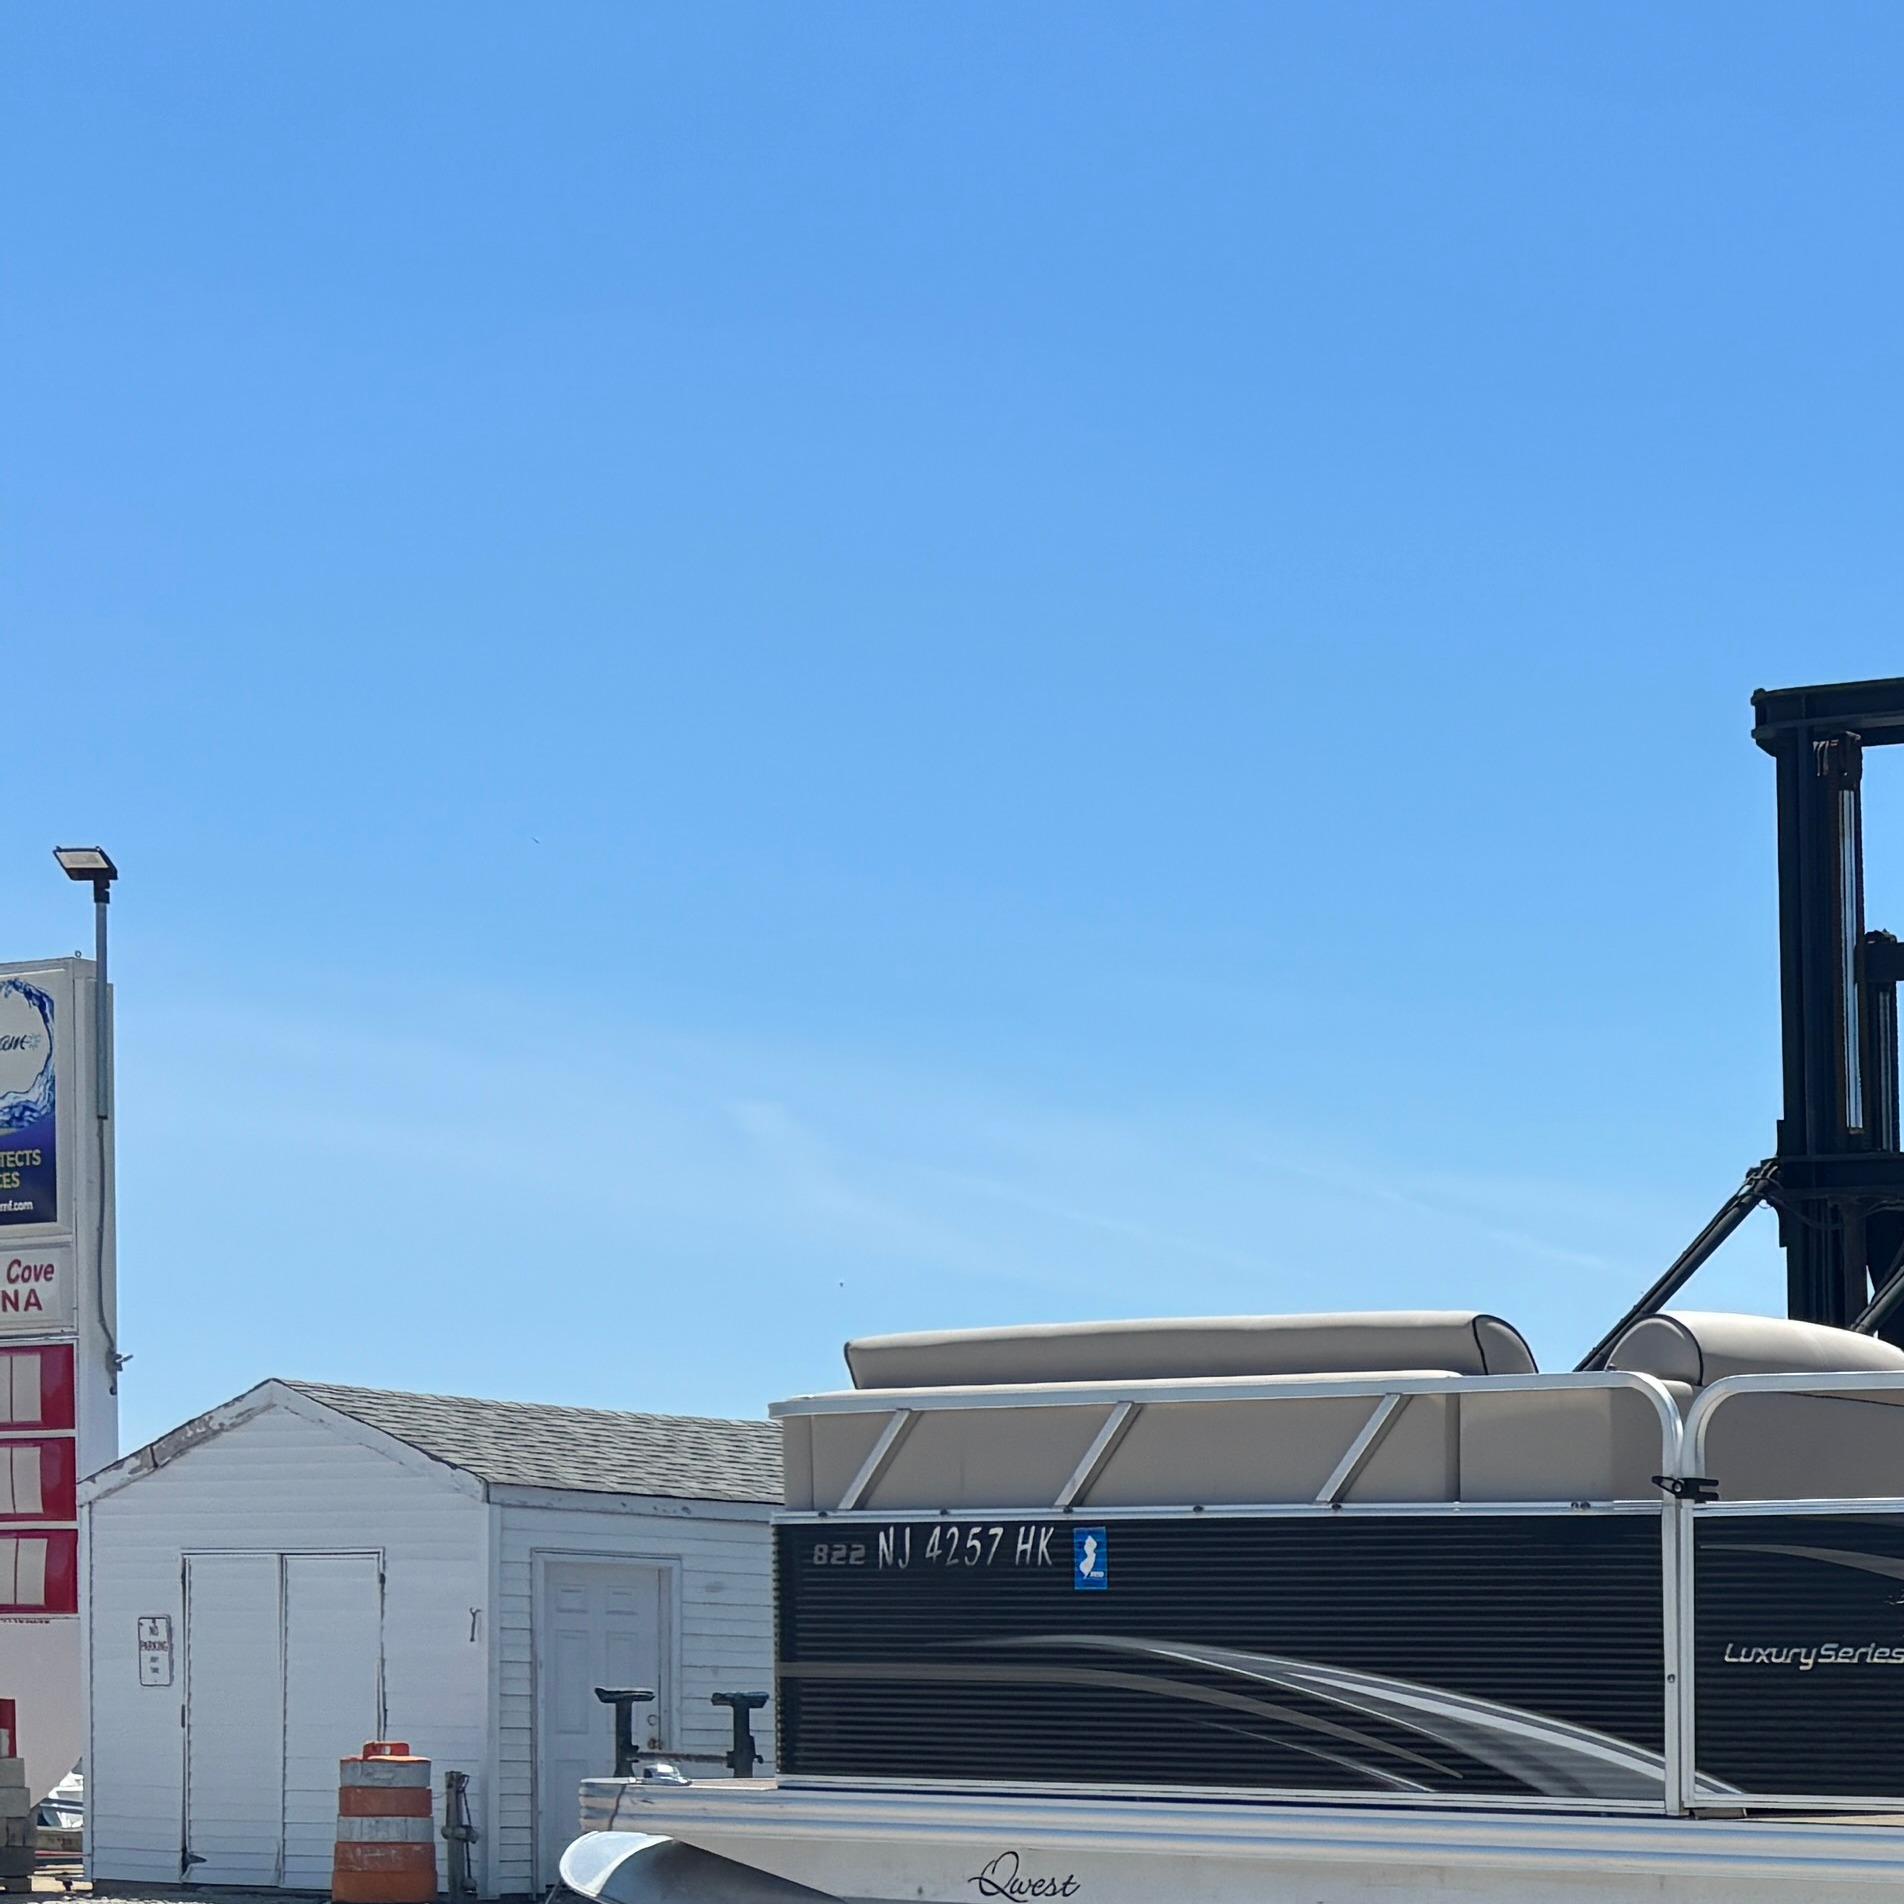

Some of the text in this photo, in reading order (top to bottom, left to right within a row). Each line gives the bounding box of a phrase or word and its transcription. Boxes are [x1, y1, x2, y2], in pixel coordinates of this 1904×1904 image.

[6, 1258, 55, 1285] Cove
[813, 1544, 865, 1565] 822
[878, 1525, 1055, 1570] NJ 4257 HK
[967, 1850, 1081, 1903] Qwest
